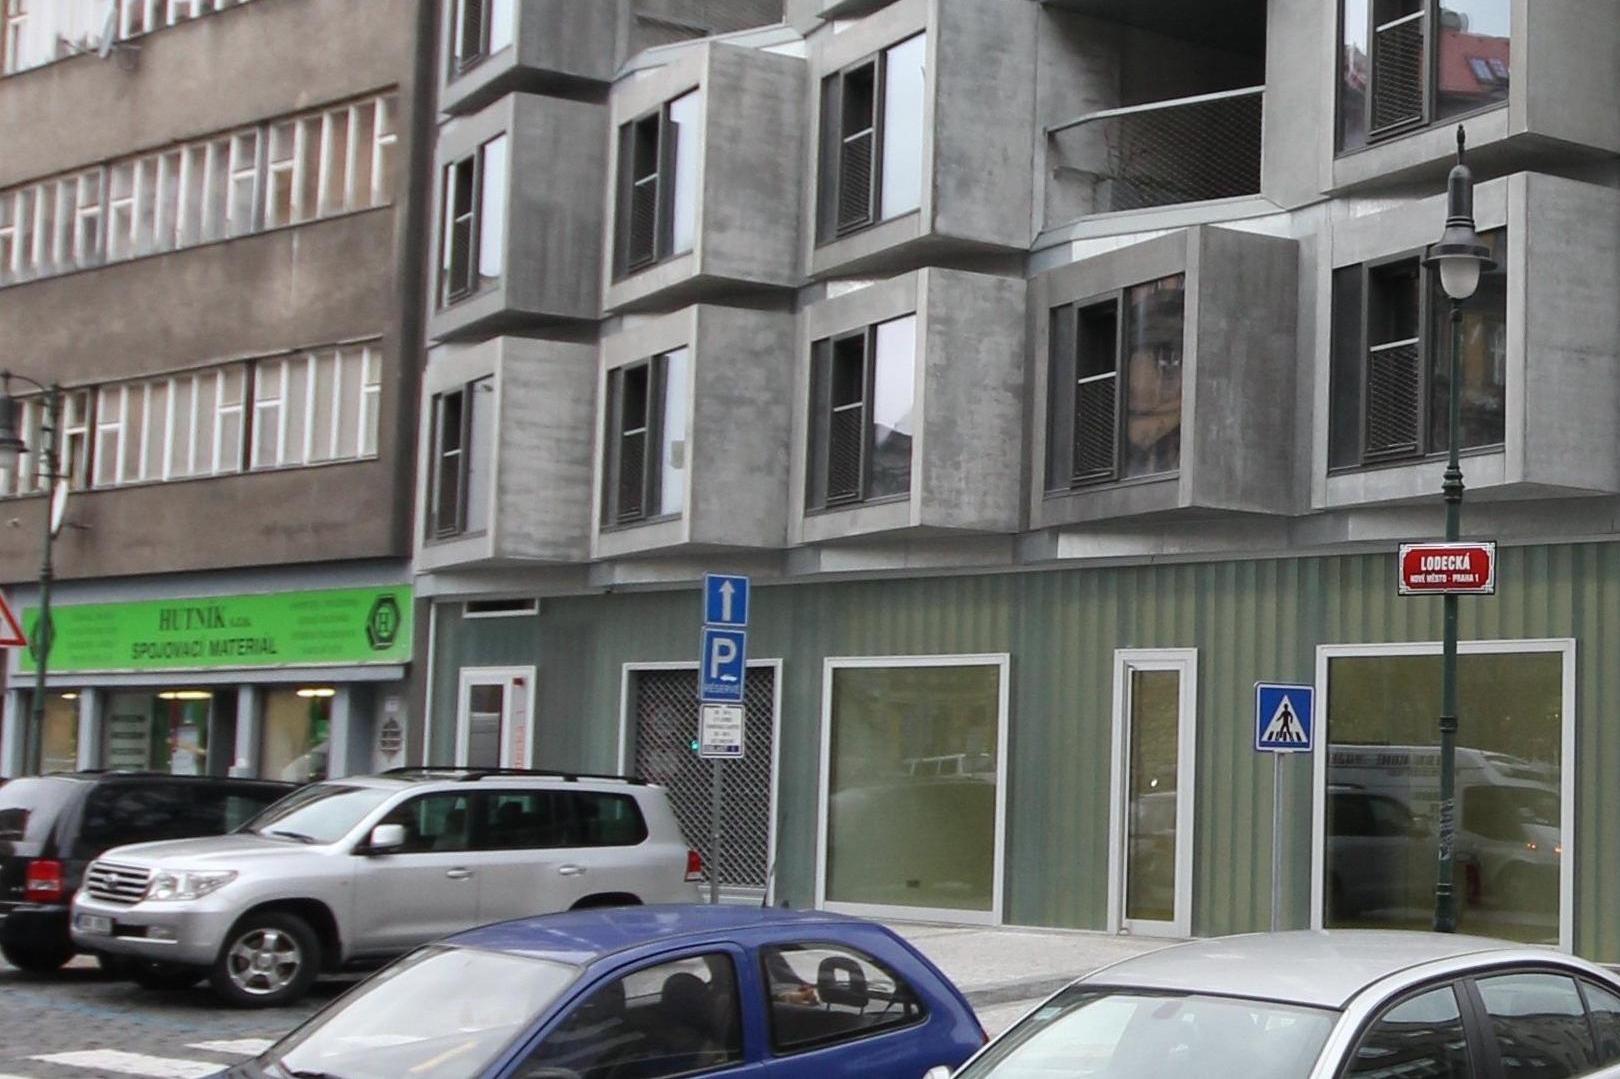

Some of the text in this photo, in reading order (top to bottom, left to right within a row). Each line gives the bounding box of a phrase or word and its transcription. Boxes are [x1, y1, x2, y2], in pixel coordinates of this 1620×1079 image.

[1420, 552, 1471, 571] LODECKÁ
[1452, 574, 1474, 583] PRAHA
[208, 632, 277, 657] MATERIÁL
[710, 637, 737, 679] P
